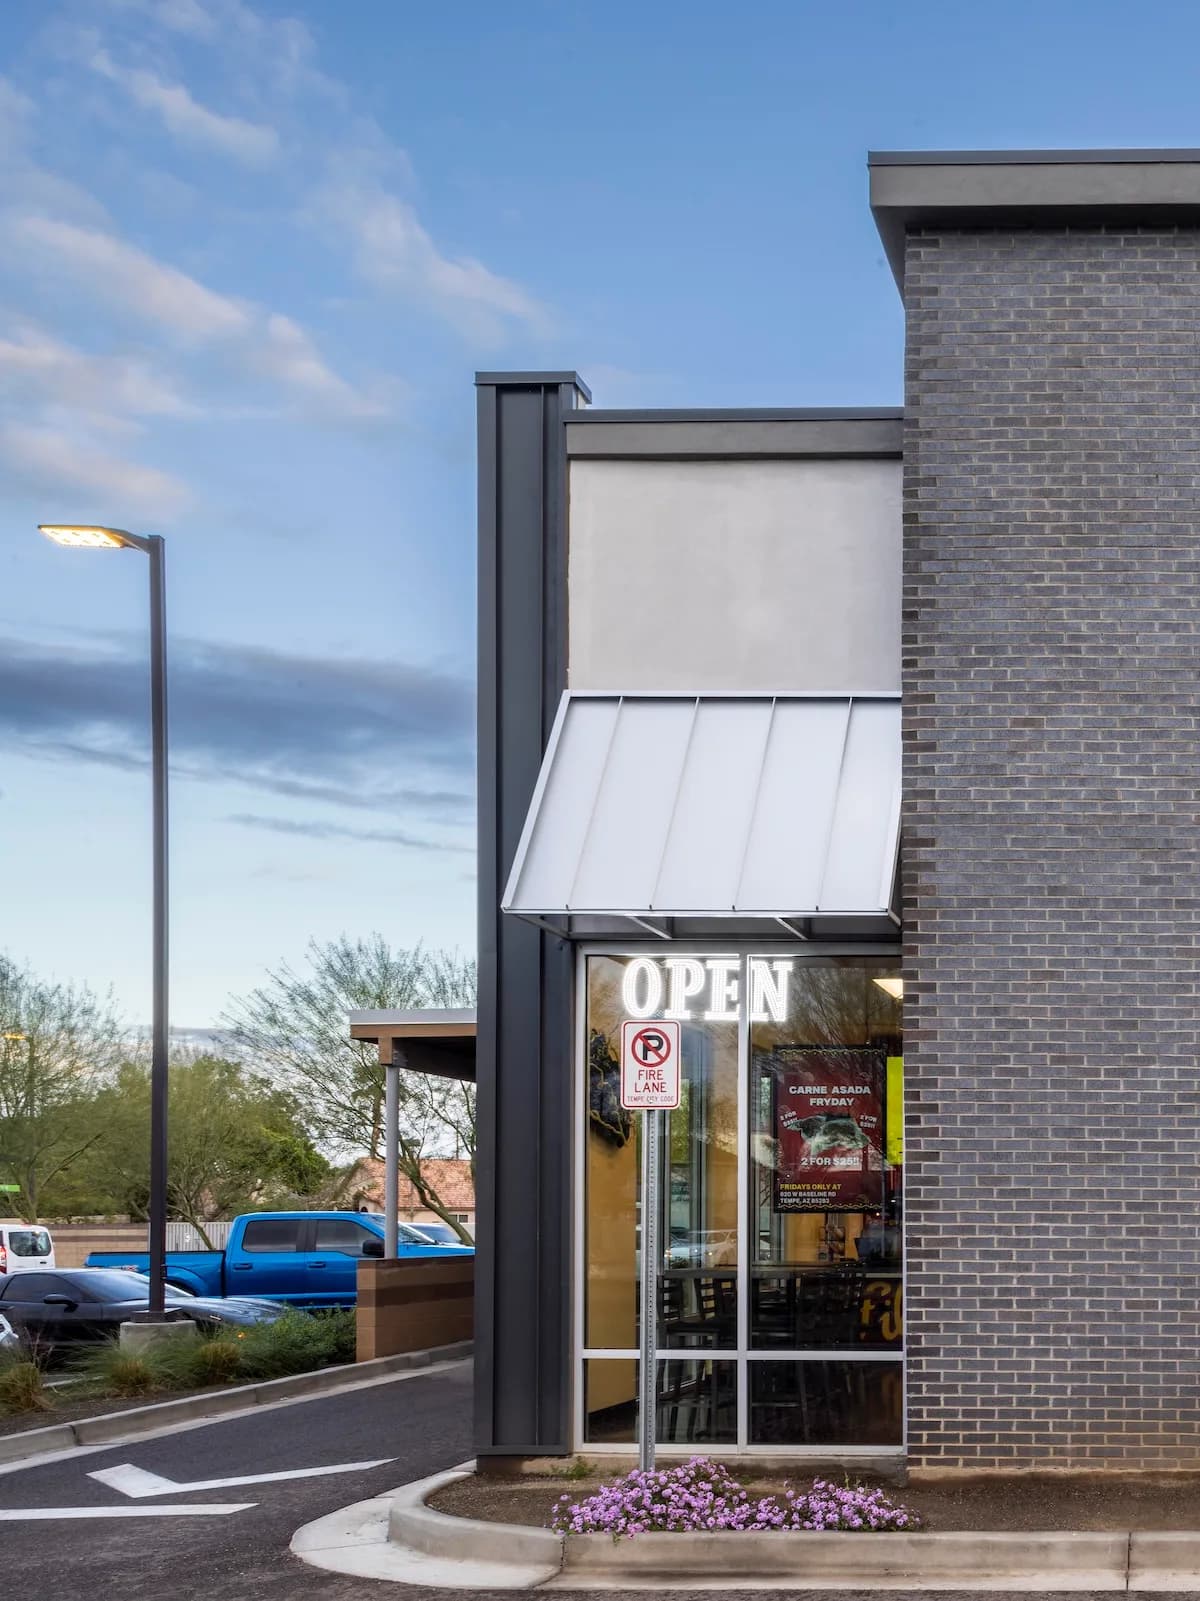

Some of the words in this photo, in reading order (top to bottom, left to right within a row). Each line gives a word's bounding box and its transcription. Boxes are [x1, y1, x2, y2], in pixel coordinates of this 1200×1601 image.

[622, 958, 793, 1022] OPEN
[638, 1069, 664, 1081] FIRE
[634, 1082, 668, 1093] LANE
[789, 1085, 828, 1095] CARNE
[831, 1085, 871, 1095] ASADA
[809, 1097, 855, 1106] FRYDAY
[801, 1157, 809, 1166] 2
[810, 1157, 831, 1166] FOR
